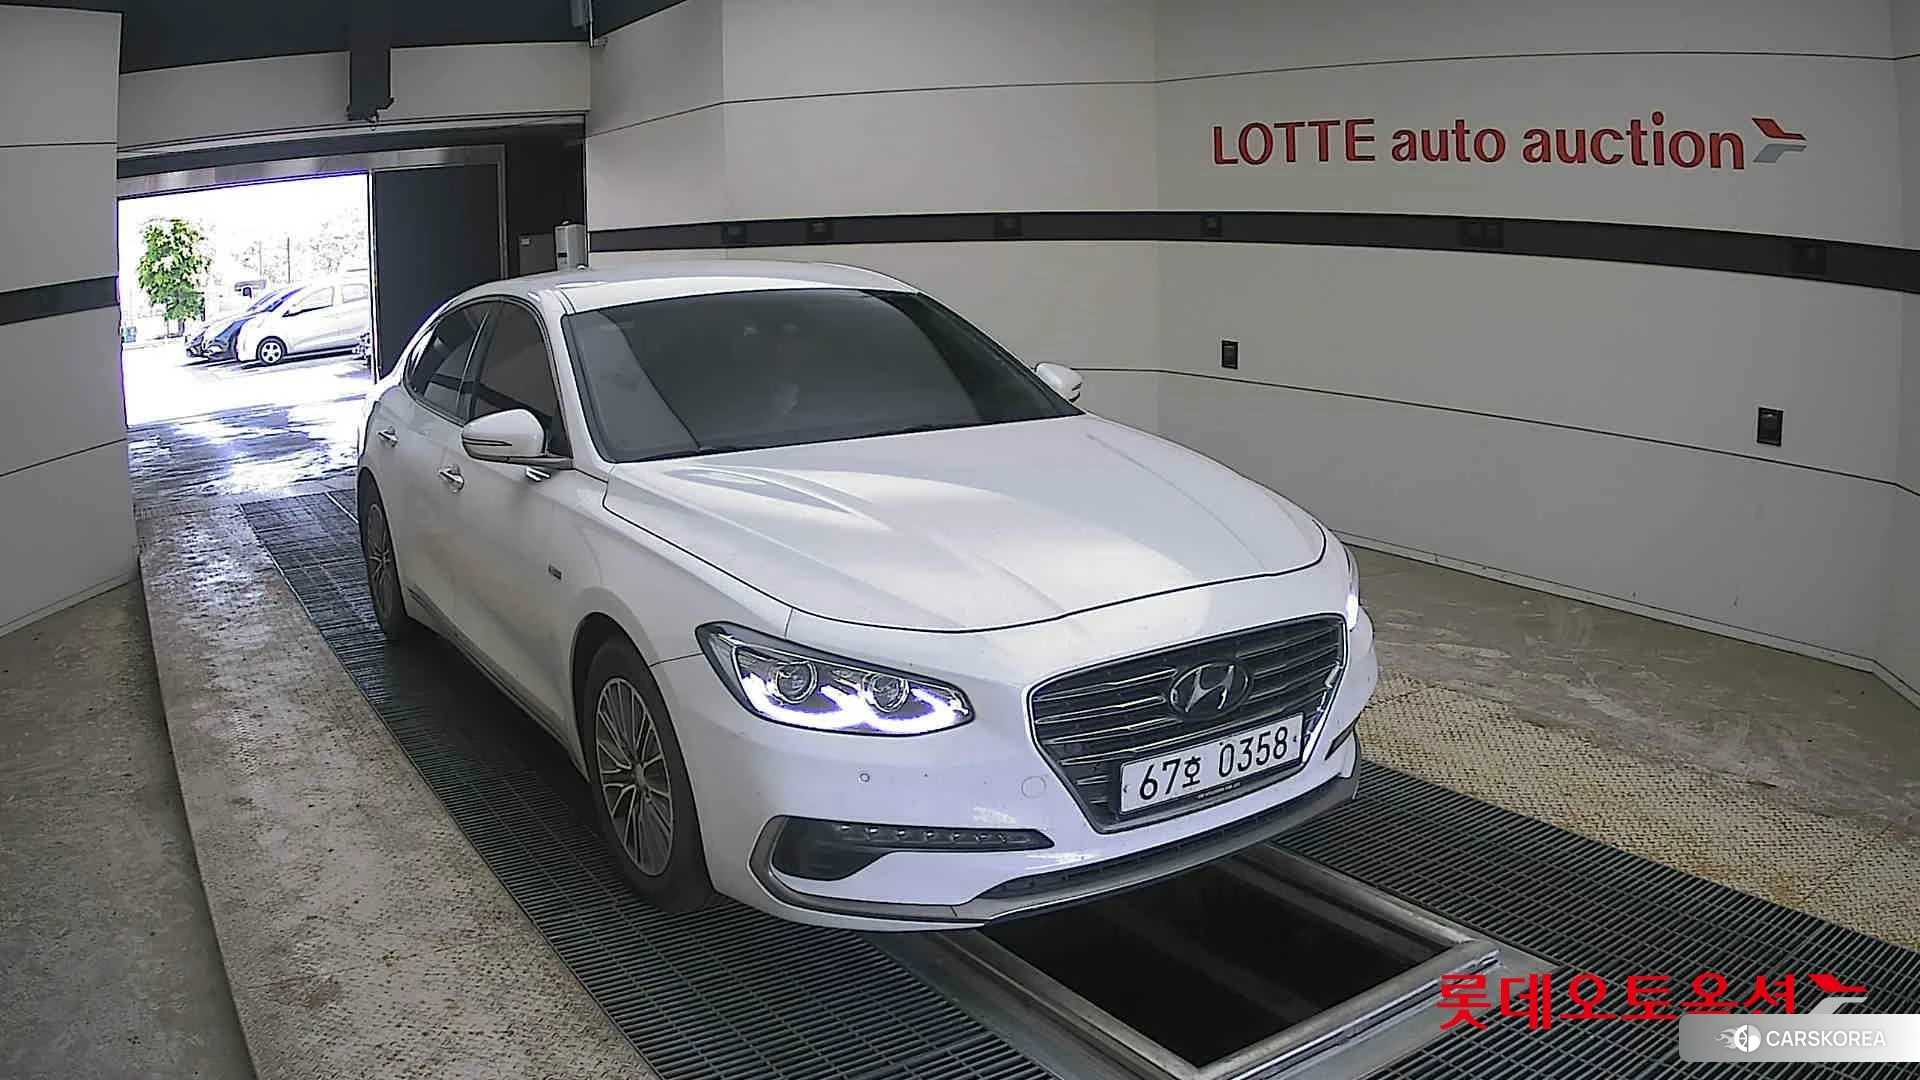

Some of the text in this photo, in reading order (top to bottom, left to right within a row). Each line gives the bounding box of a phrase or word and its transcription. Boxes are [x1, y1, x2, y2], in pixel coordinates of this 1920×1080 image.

[1213, 111, 1745, 170] LOTTE auto auction
[1139, 757, 1201, 800] 67호
[1218, 726, 1289, 778] 0358
